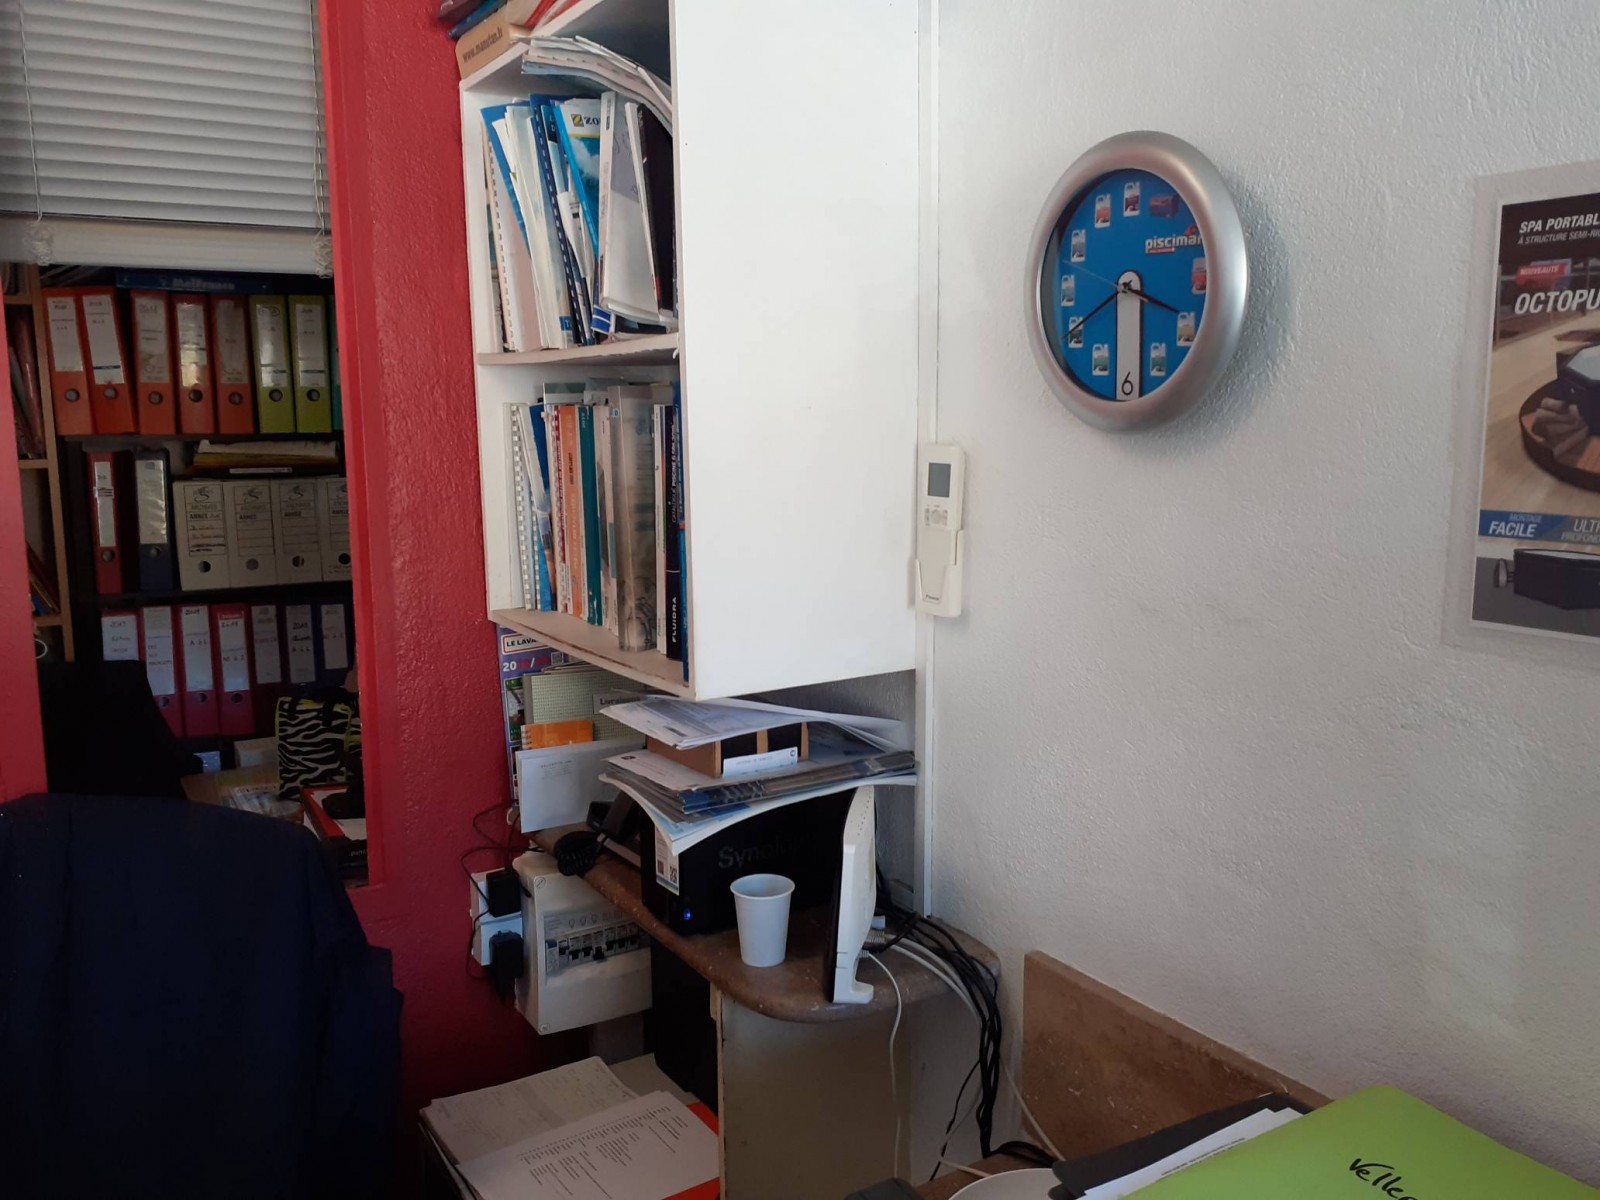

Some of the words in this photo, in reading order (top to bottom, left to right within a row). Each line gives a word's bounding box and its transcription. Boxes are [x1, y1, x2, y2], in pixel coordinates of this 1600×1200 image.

[583, 115, 600, 126] ZO
[1519, 220, 1542, 234] SPA
[1545, 213, 1600, 231] PORTABL
[1514, 288, 1600, 315] OCTOPU
[1121, 371, 1134, 396] 6
[1488, 520, 1537, 538] FACILE
[506, 640, 516, 648] LE
